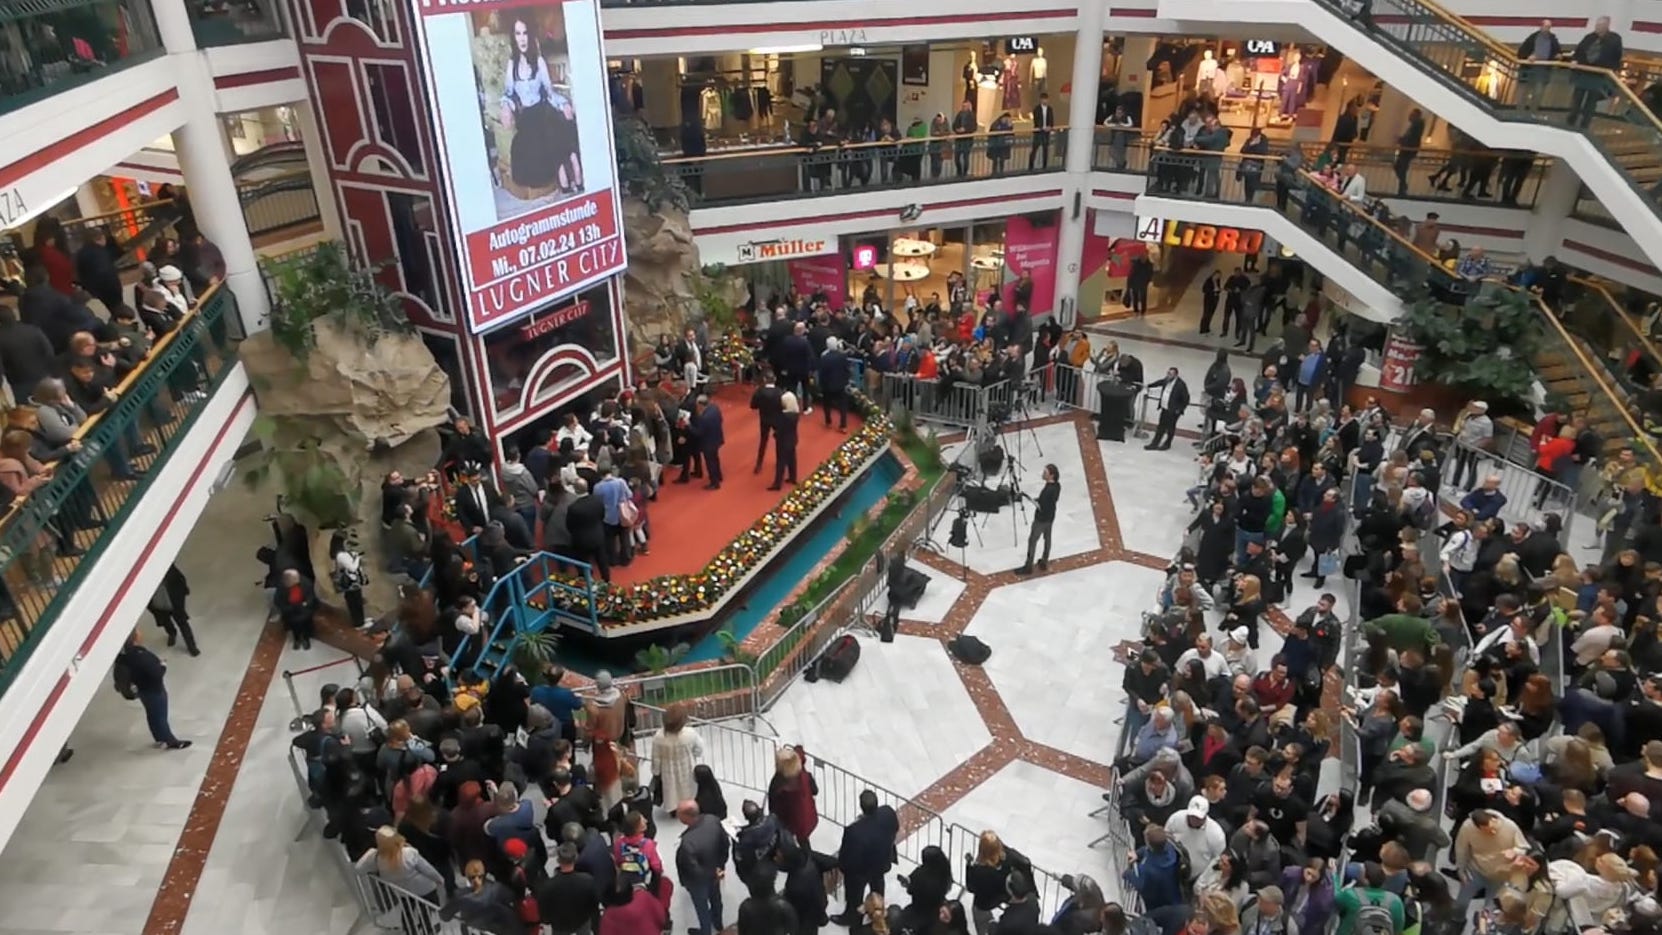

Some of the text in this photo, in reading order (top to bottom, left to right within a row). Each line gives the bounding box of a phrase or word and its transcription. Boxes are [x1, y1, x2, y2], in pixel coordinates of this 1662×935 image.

[820, 29, 867, 44] PLAZA
[490, 200, 598, 251] Autogrammstunde
[518, 231, 575, 267] 07.02.24
[579, 222, 601, 245] 13h
[760, 237, 825, 257] Müller
[478, 240, 618, 317] LUGNER CITY
